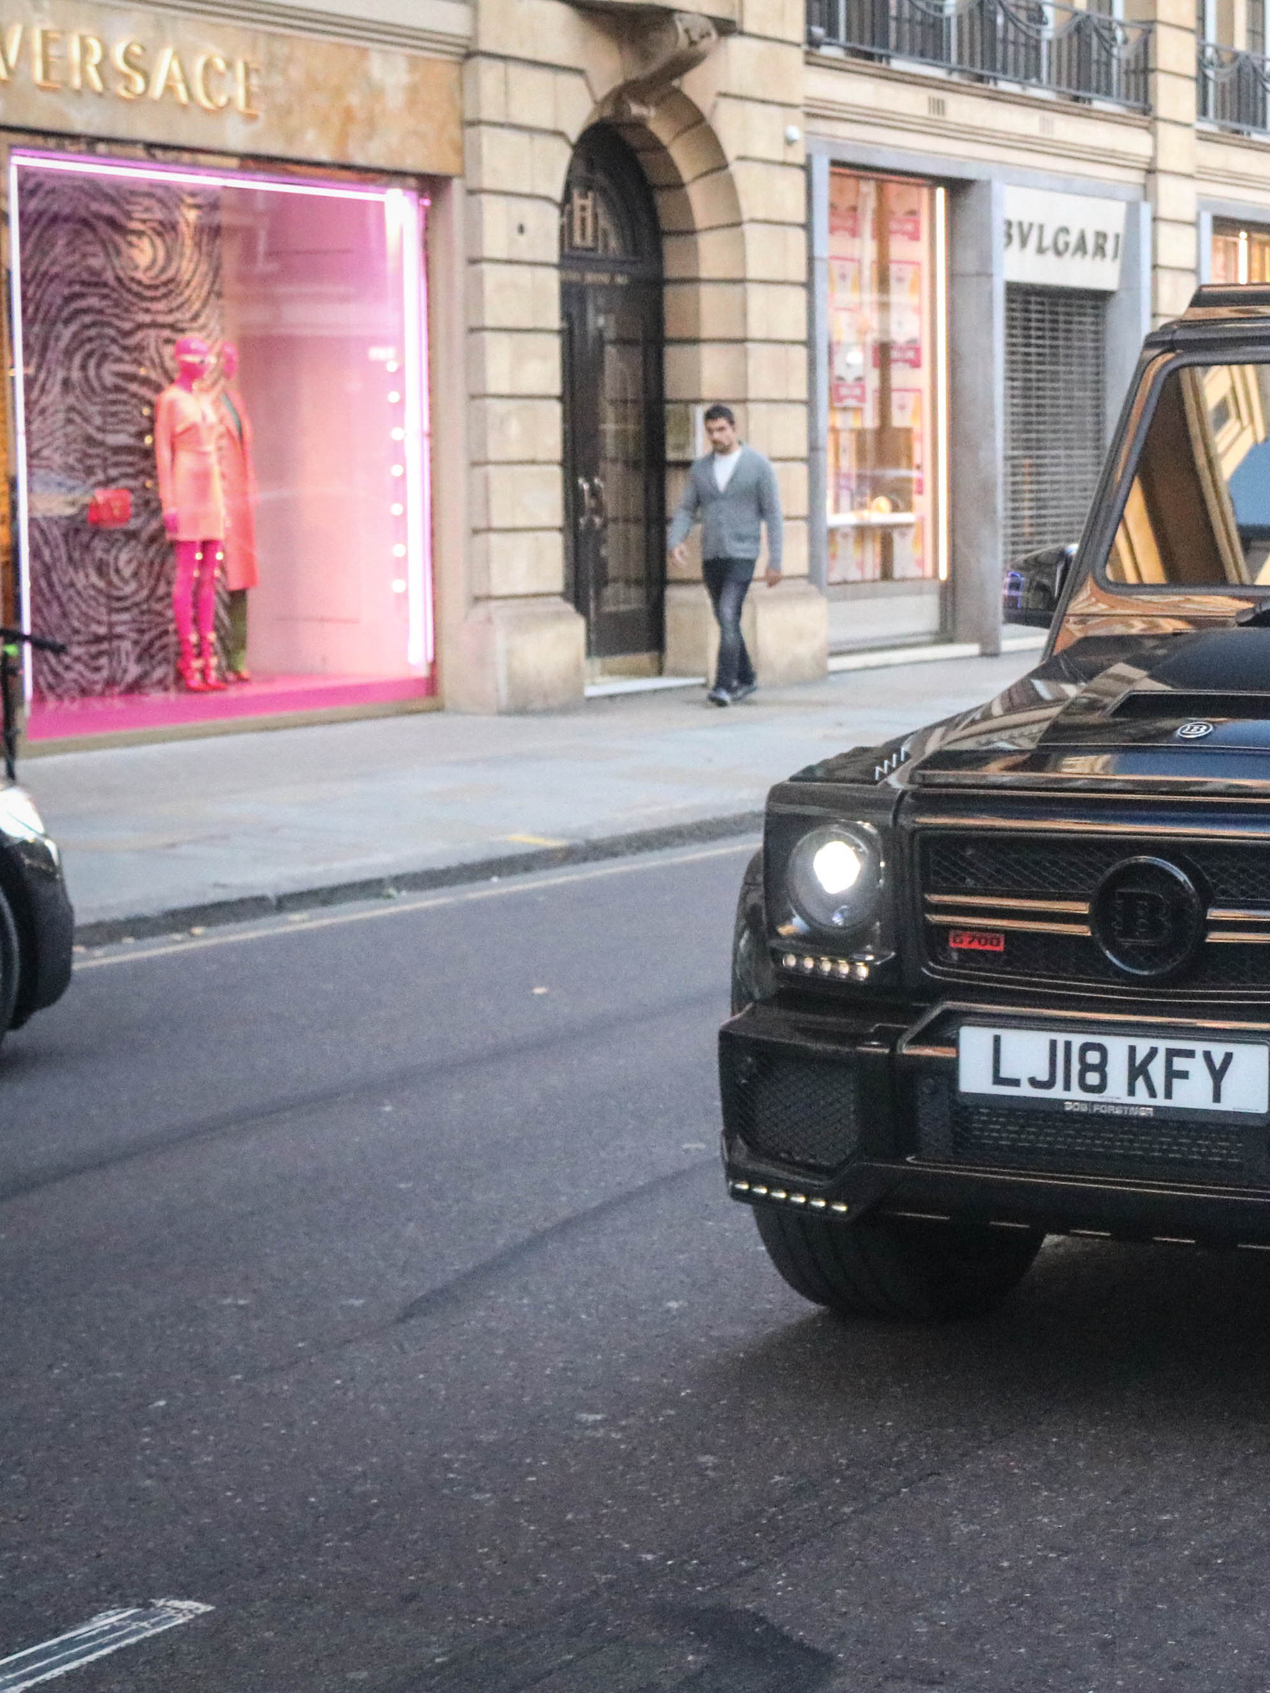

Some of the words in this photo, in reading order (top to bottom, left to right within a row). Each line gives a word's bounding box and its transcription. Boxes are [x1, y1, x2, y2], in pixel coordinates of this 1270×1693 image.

[0, 23, 261, 118] VERSACE
[992, 1034, 1108, 1094] LJ18
[1127, 1045, 1233, 1103] KFY
